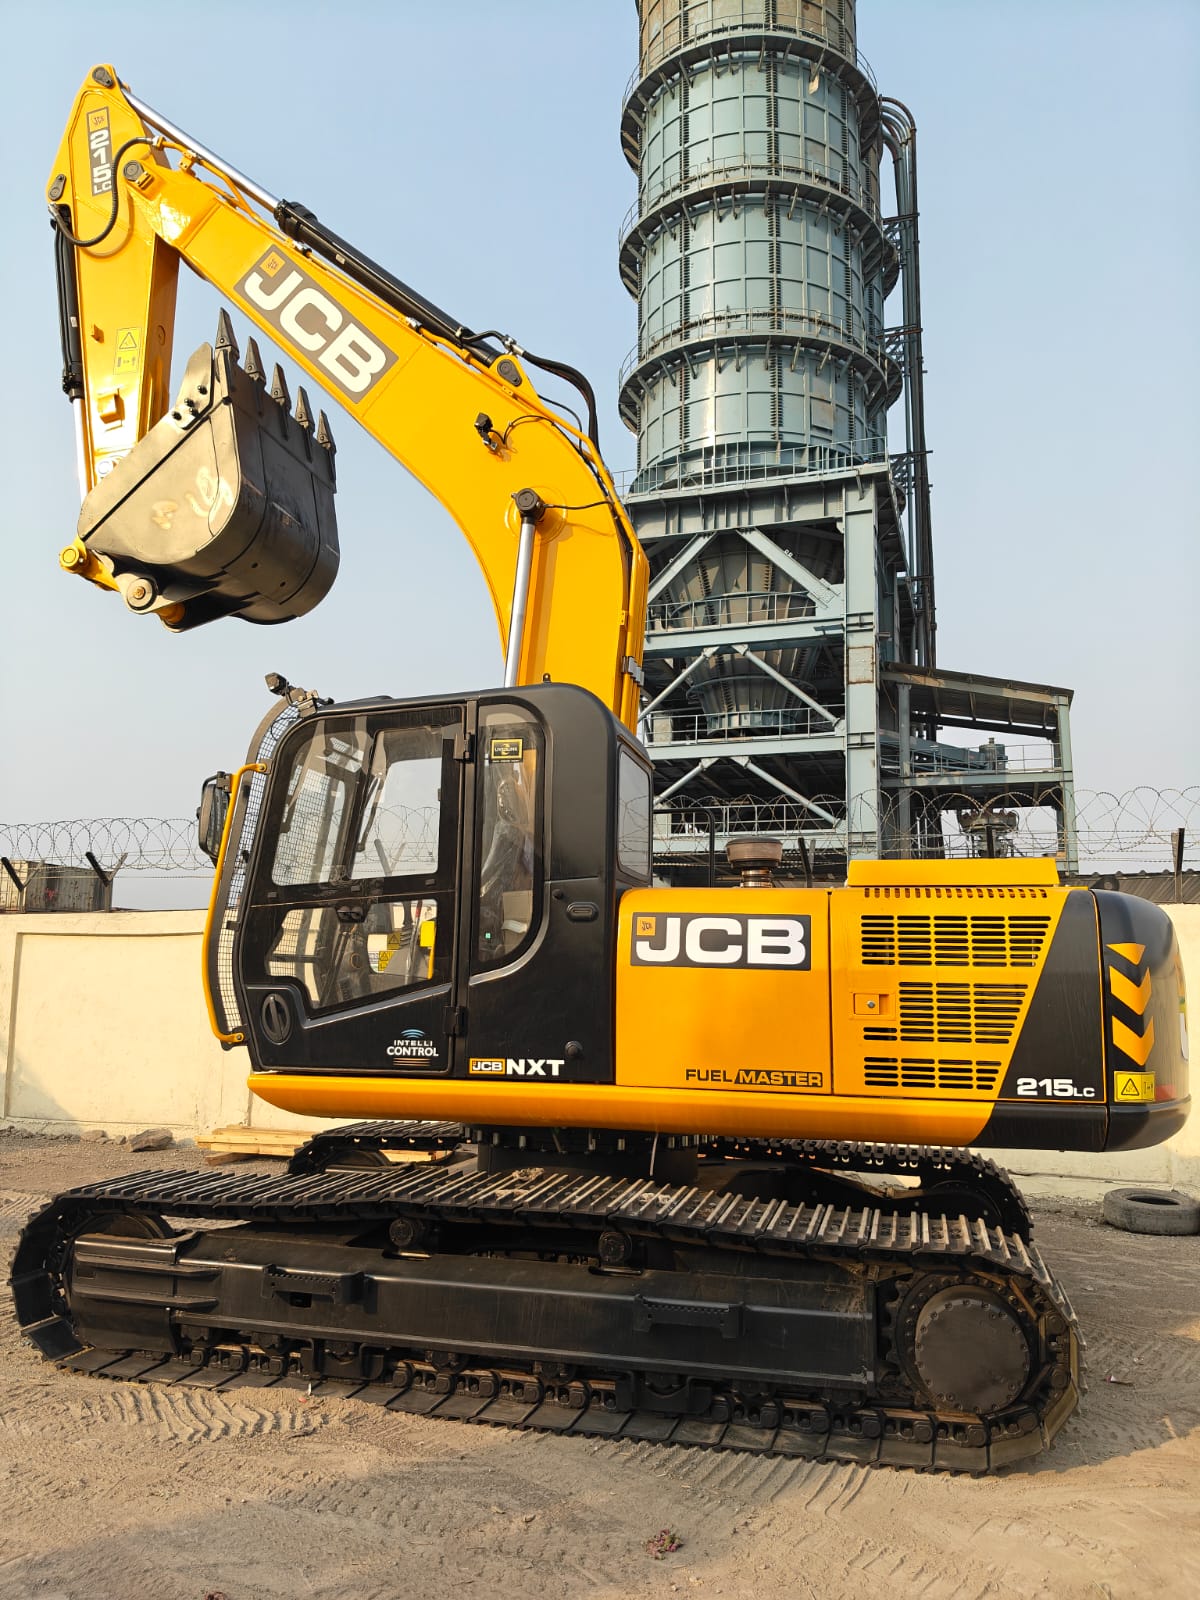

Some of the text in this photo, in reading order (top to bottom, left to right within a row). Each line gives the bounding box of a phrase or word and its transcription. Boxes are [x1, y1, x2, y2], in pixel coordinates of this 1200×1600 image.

[244, 270, 387, 393] JCB
[636, 917, 807, 965] JCB
[386, 1046, 439, 1057] CONTROL
[393, 1039, 433, 1047] INTELLI
[472, 1058, 565, 1076] JCB NXT
[685, 1068, 822, 1087] FUEL MASTER
